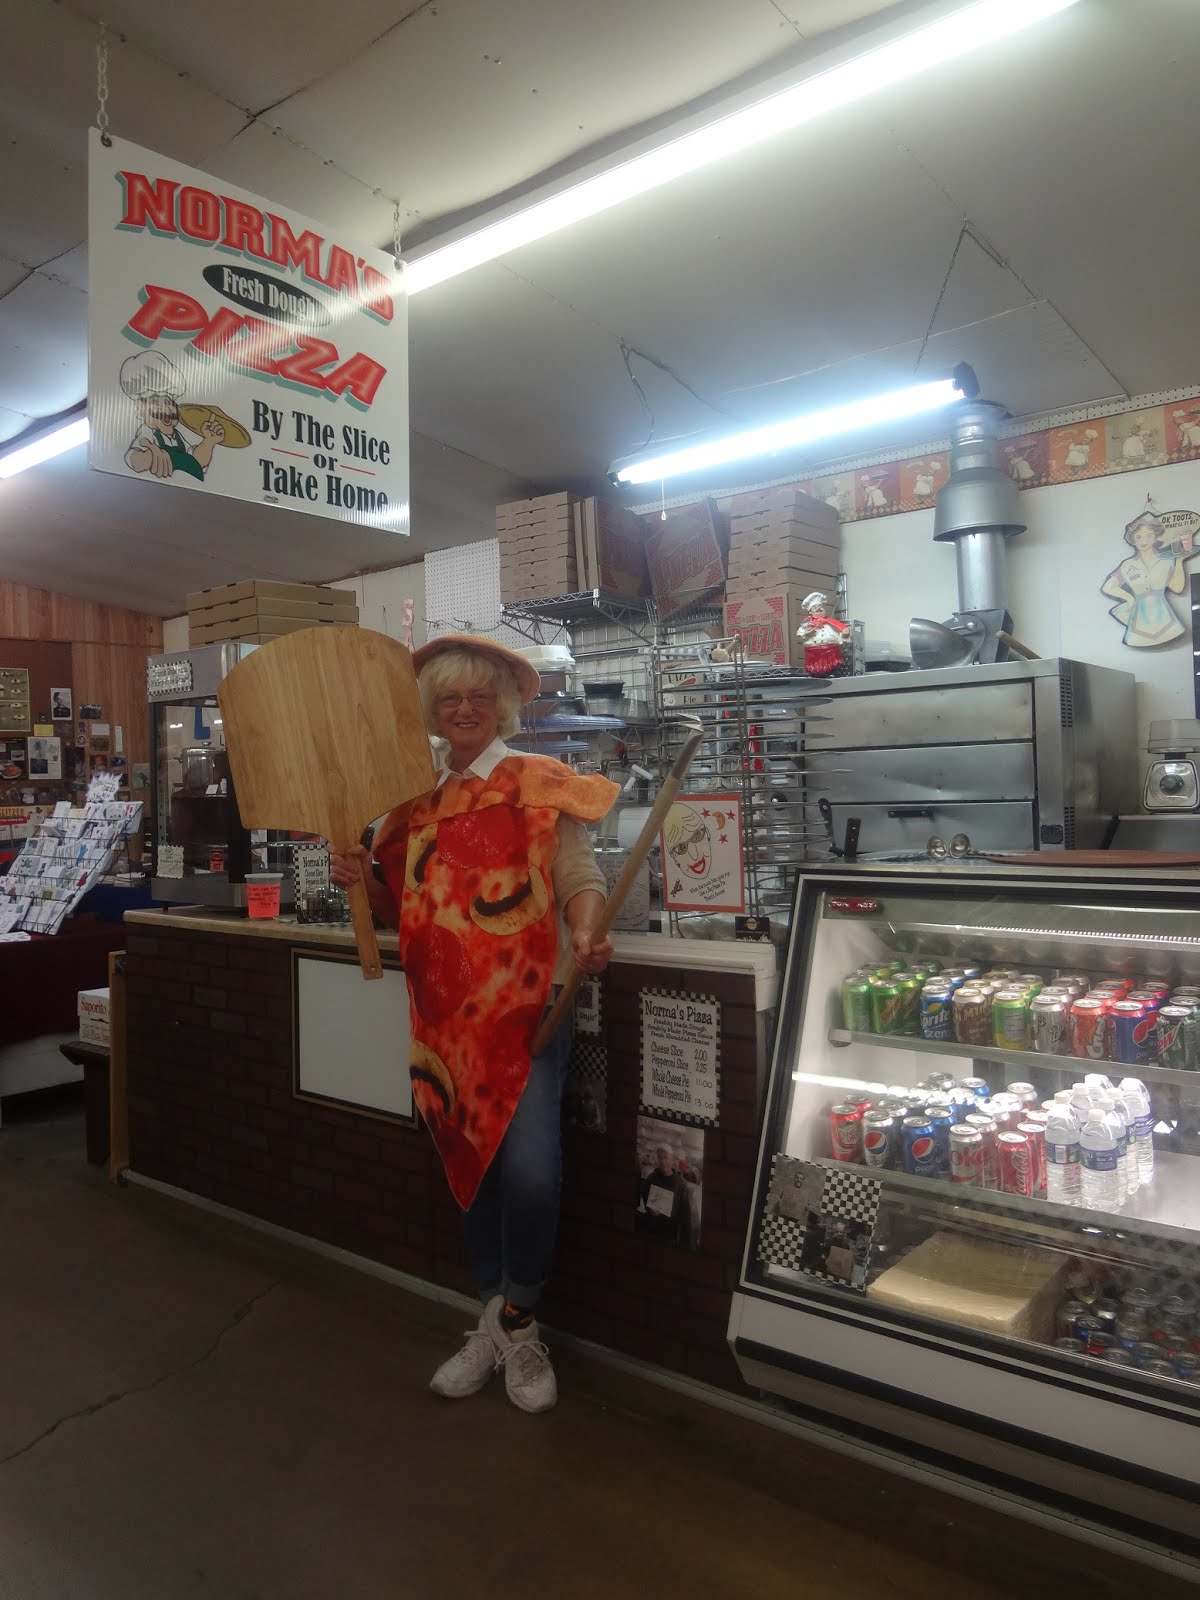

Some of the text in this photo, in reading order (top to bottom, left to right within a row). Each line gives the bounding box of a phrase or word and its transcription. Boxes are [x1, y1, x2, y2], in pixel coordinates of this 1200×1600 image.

[115, 170, 395, 325] NORMA'S
[222, 266, 320, 324] Fresh Dough
[121, 284, 388, 412] PIZZA
[252, 399, 391, 465] By The Slice
[313, 454, 339, 472] or
[258, 459, 389, 514] Take Home
[727, 620, 783, 656] PIZZA
[645, 1000, 713, 1025] Norma's Pizza
[651, 1041, 670, 1055] Cheese
[670, 1044, 683, 1057] Slice
[651, 1053, 676, 1068] Pepperoni
[676, 1058, 689, 1070] Slice
